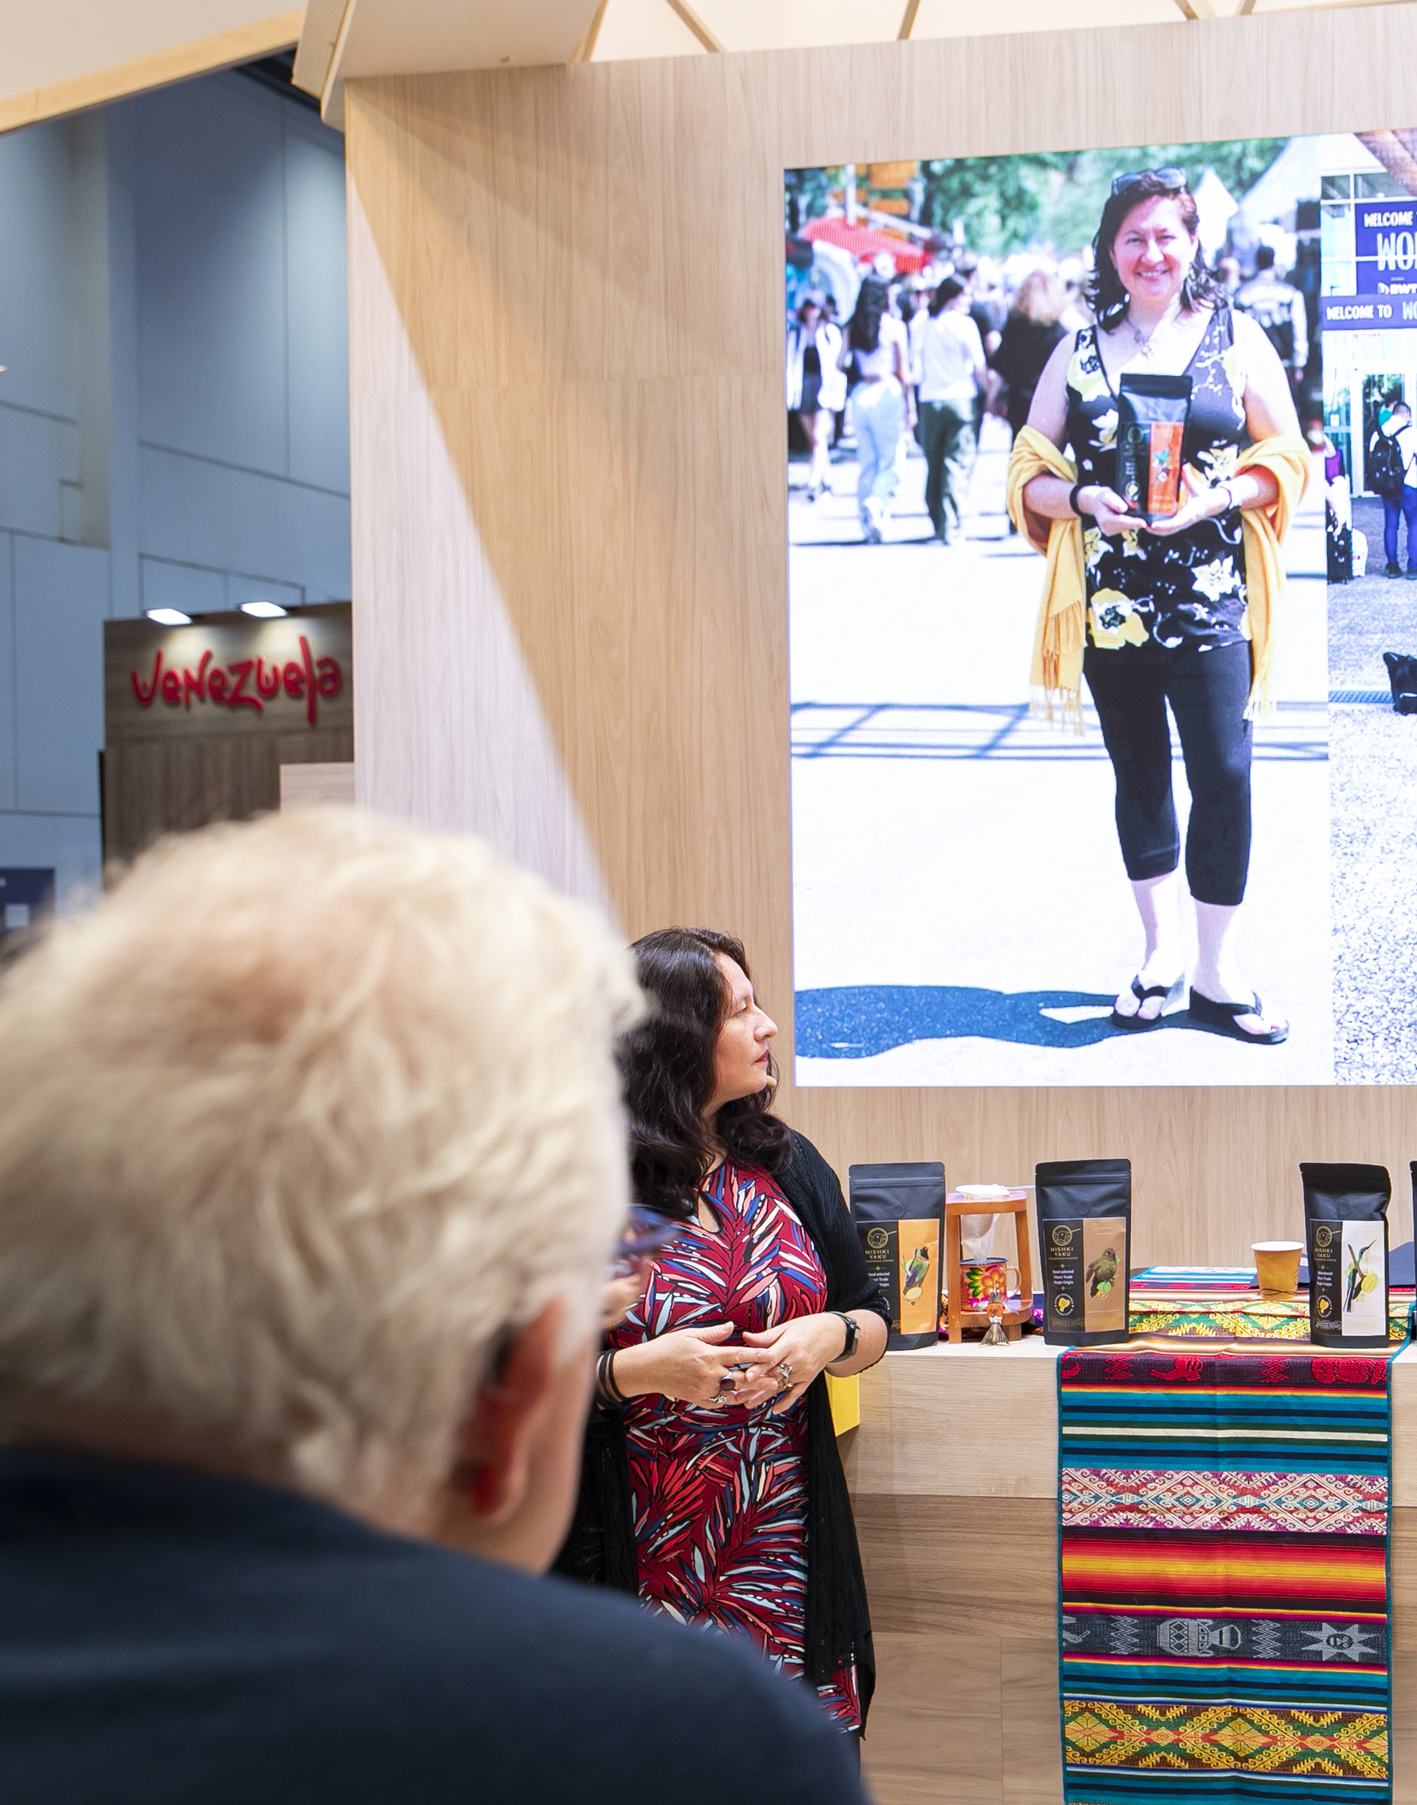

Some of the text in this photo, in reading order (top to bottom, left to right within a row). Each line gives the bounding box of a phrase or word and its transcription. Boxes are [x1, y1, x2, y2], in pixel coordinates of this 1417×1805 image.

[1364, 211, 1413, 227] WELCOME
[1326, 304, 1373, 320] WELCOME
[1377, 304, 1392, 319] TO
